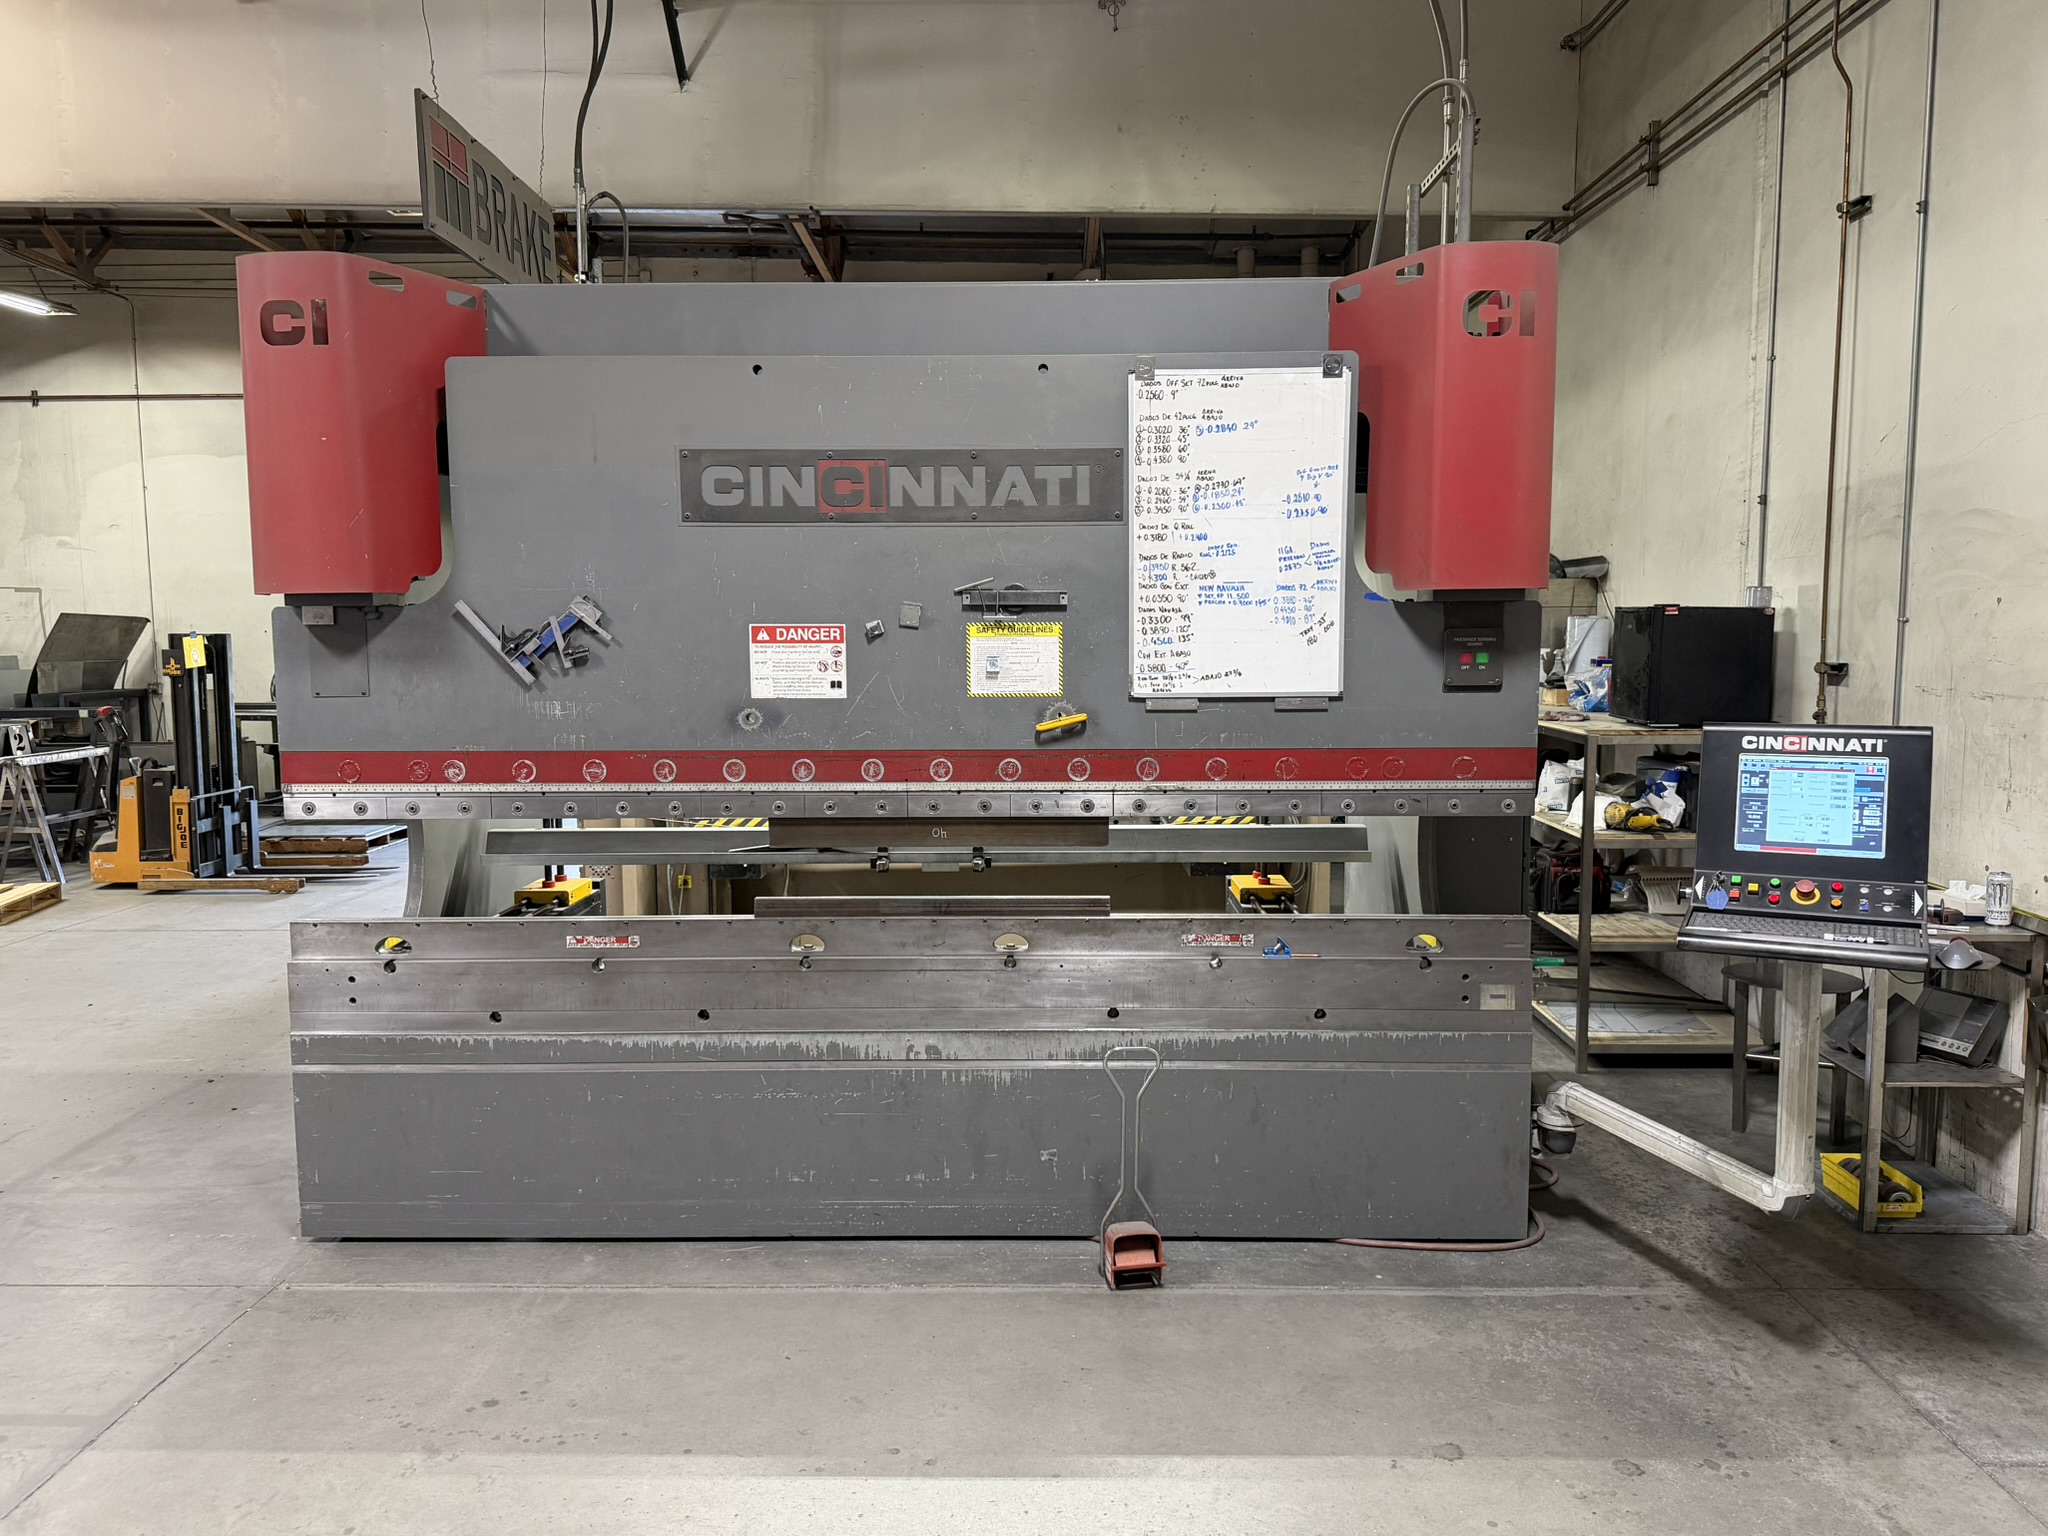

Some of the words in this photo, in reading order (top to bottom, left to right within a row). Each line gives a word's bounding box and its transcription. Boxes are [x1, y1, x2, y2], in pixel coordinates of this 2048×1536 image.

[472, 158, 553, 284] BRAKE
[260, 299, 329, 346] CI
[1462, 289, 1536, 338] CI
[700, 464, 1091, 507] CINCINNATI
[776, 628, 841, 640] DANGER
[14, 733, 26, 751] 2
[1741, 735, 1883, 753] CINCINNATI
